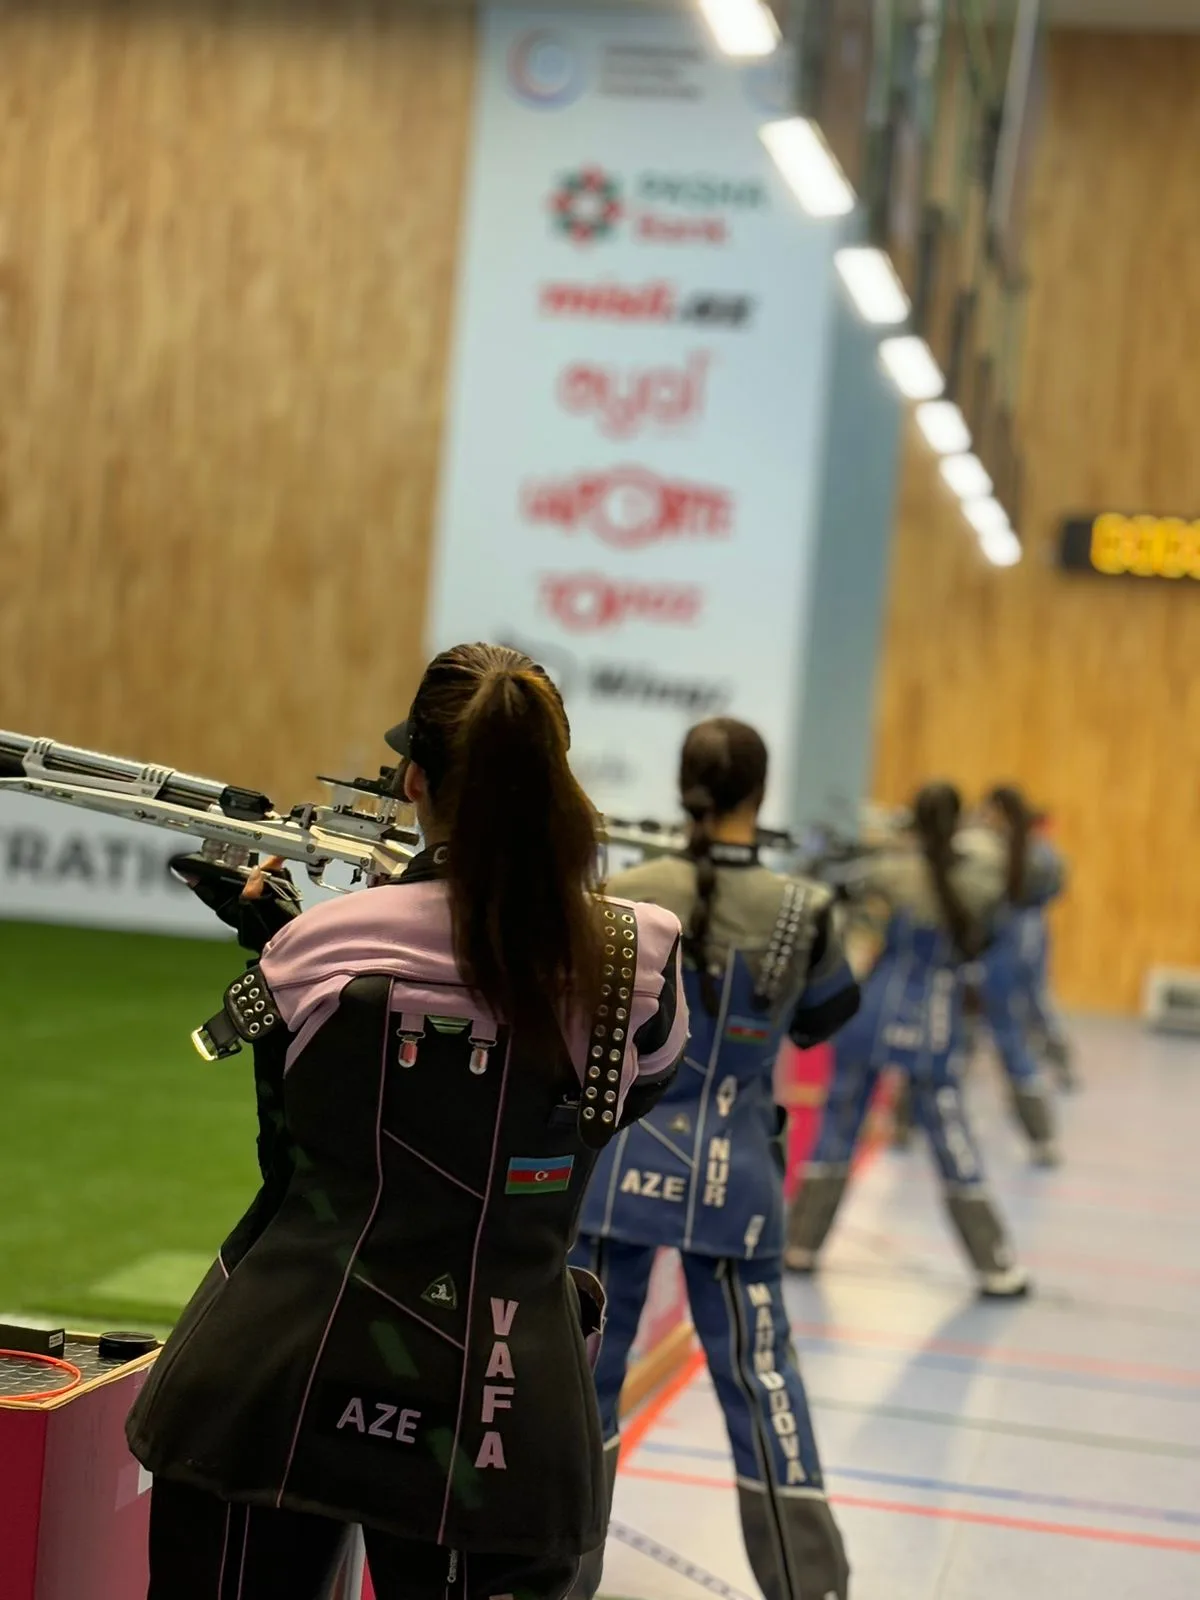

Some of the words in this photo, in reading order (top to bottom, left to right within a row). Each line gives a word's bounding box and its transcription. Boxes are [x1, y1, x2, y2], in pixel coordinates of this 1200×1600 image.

[620, 1168, 688, 1202] AZE
[475, 1296, 519, 1470] VAFA
[336, 1397, 422, 1444] AZE
